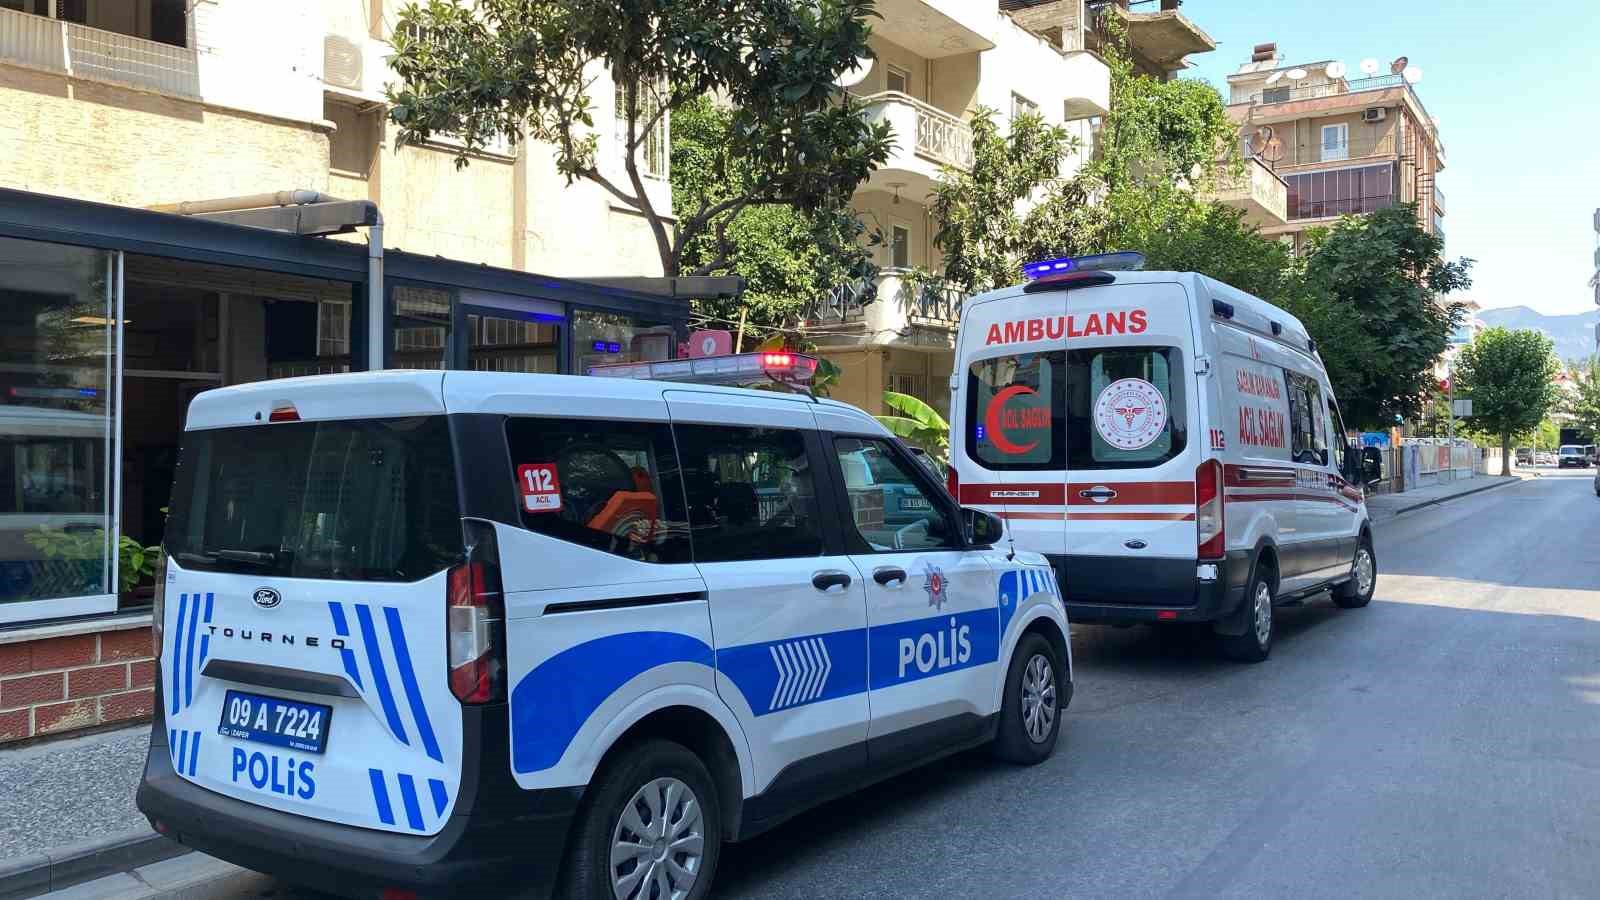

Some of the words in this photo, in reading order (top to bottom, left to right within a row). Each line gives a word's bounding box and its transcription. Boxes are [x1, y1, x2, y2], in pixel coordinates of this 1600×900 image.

[985, 309, 1148, 345] AMBULANS
[1209, 429, 1225, 449] 112
[524, 468, 554, 491] 112
[208, 625, 345, 649] TOURNEO
[229, 697, 251, 727] 09
[253, 702, 268, 731] A
[275, 705, 321, 740] 7224
